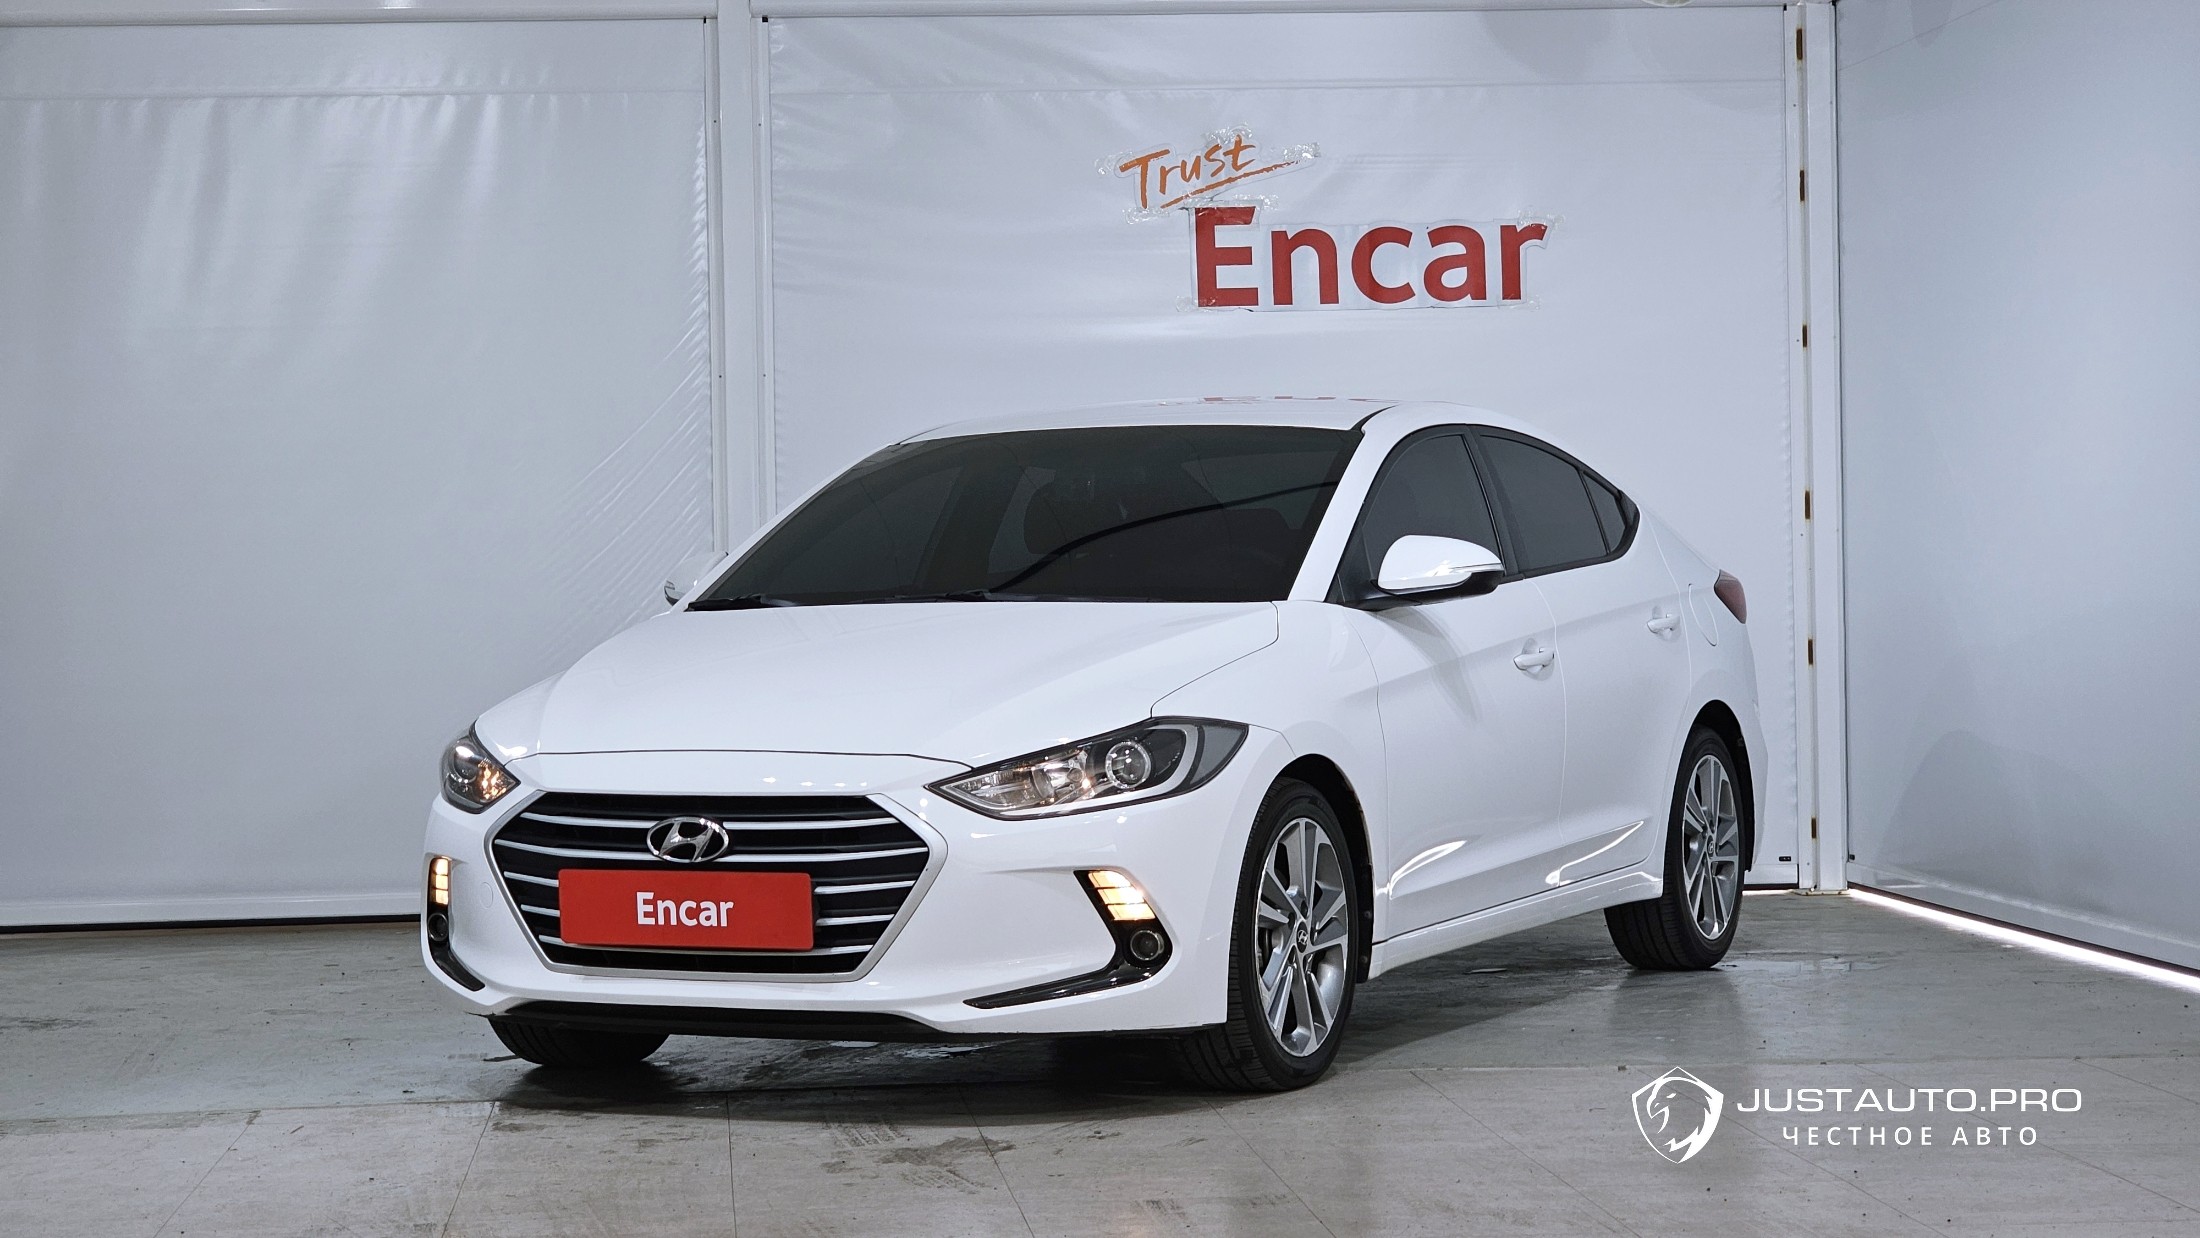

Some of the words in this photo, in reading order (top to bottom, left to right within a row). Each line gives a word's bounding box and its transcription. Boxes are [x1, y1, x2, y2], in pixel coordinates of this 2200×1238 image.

[1119, 134, 1257, 209] Trust
[1194, 206, 1549, 308] Encar
[636, 891, 734, 928] Encar
